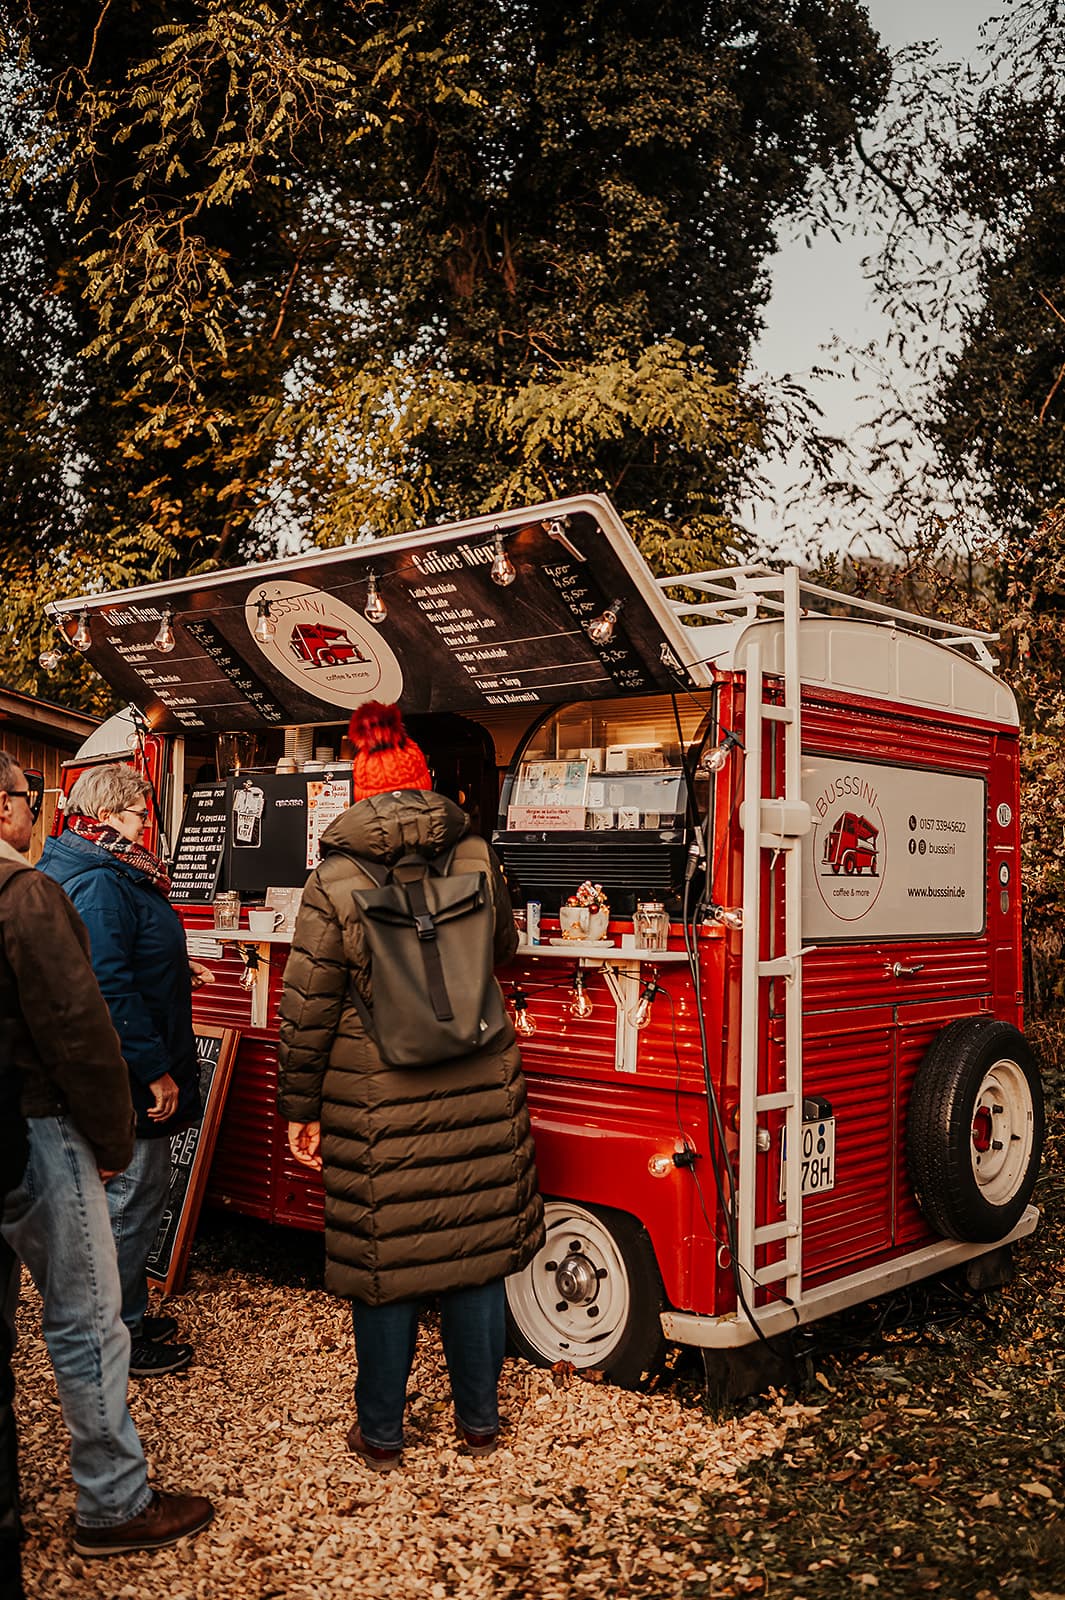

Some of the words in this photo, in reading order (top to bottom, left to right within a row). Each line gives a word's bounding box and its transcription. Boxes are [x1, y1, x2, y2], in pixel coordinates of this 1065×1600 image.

[411, 550, 463, 575] Coffee
[100, 609, 137, 626] Coffee
[815, 775, 878, 818] BUSSSINI
[920, 818, 934, 830] 0157
[929, 842, 956, 855] busssini
[832, 888, 850, 897] coffee
[855, 889, 870, 897] more
[907, 885, 966, 898] www.busssini.de
